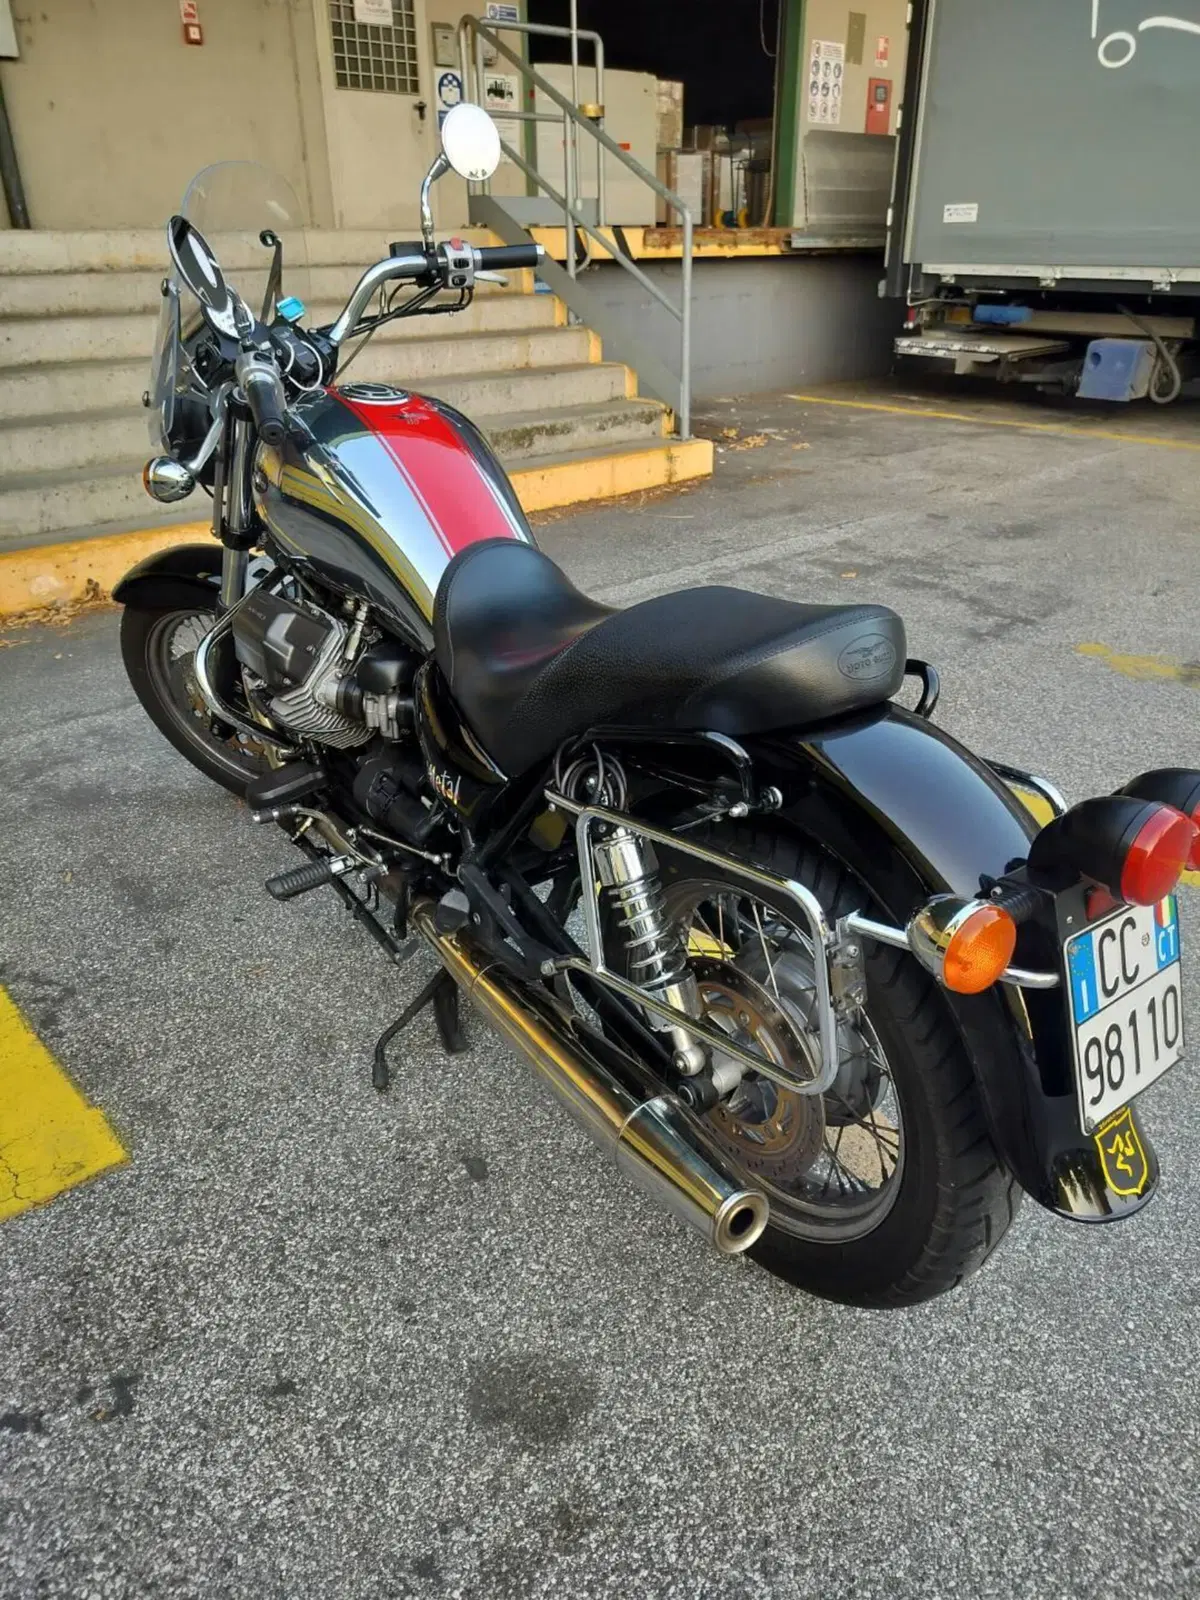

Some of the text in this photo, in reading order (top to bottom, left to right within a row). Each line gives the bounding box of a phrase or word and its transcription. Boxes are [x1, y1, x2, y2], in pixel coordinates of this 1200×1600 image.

[1098, 916, 1140, 998] CC
[1158, 923, 1175, 962] CT
[1084, 984, 1180, 1106] 98110
